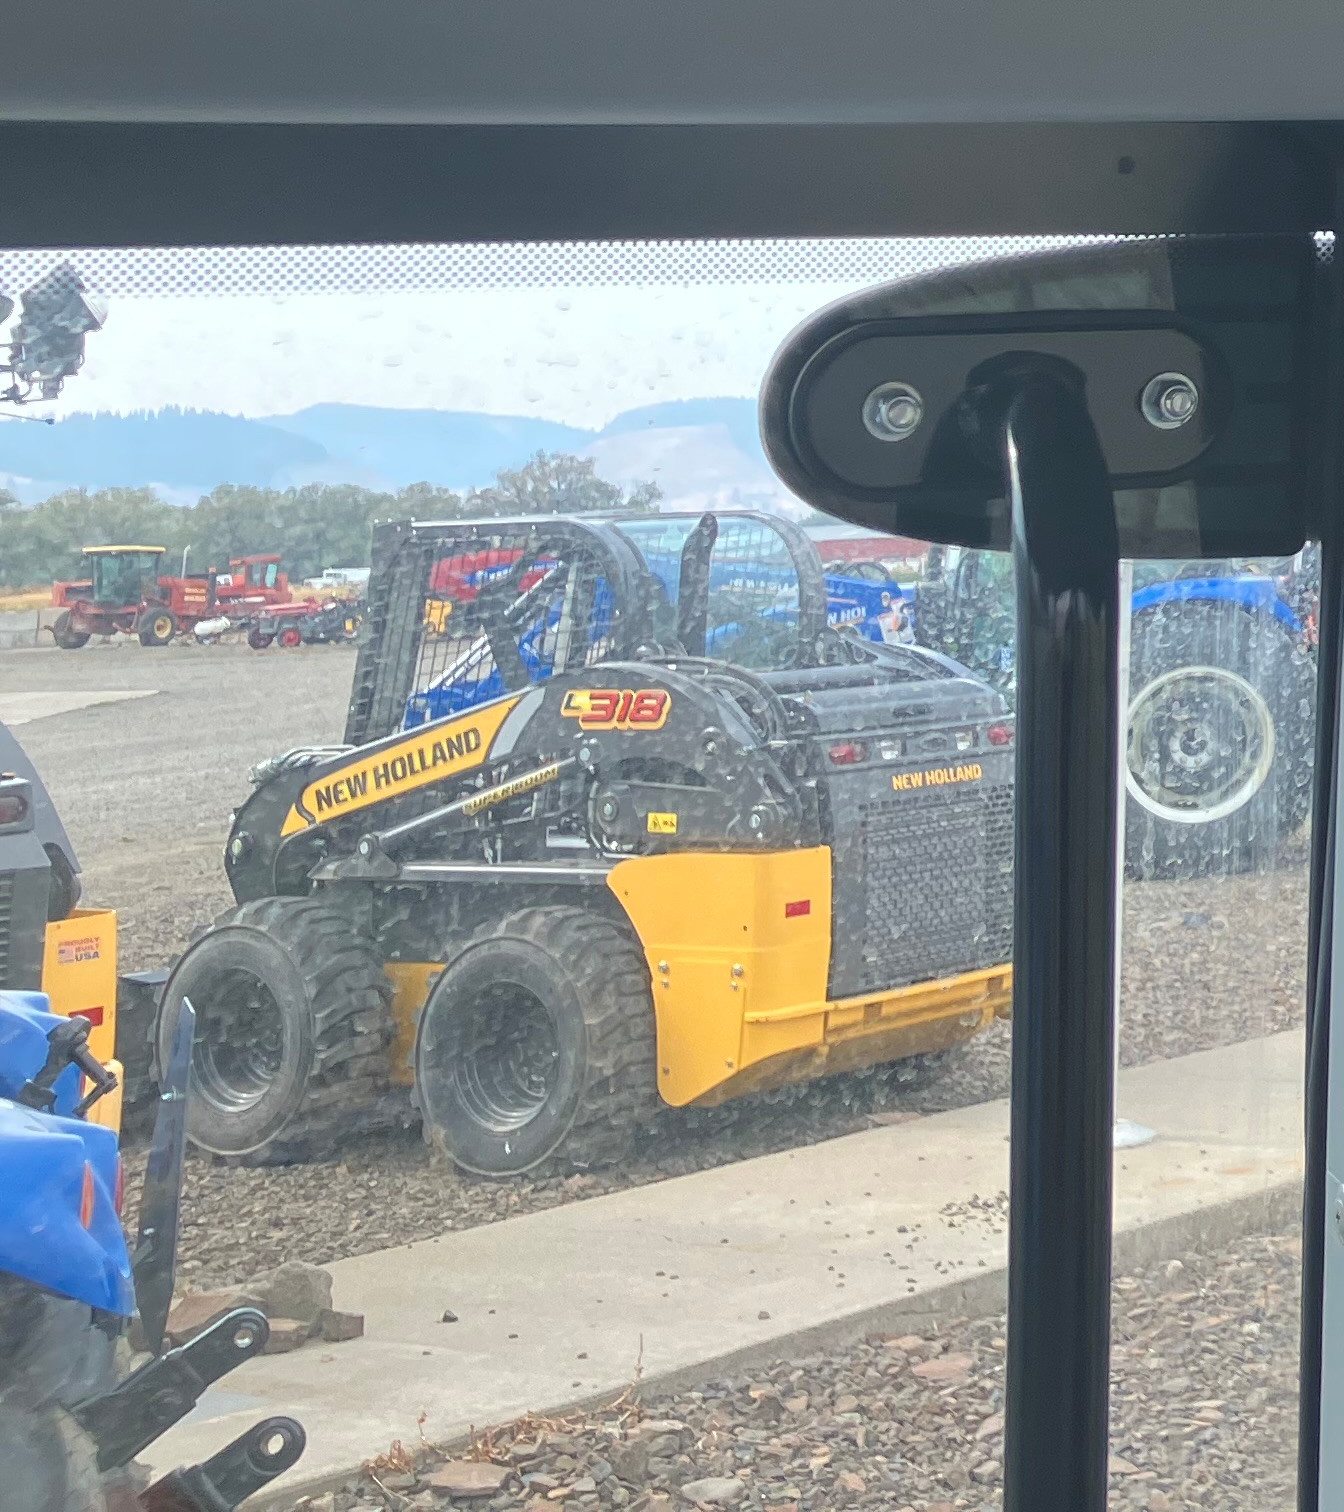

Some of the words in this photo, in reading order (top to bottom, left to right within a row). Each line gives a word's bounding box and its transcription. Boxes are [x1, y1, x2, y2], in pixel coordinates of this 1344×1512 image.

[562, 691, 669, 725] L318
[315, 770, 368, 812] NEW
[372, 727, 482, 791] HOLLAND
[892, 771, 923, 791] NEW
[925, 763, 983, 786] HOLLAND
[75, 951, 99, 961] USA
